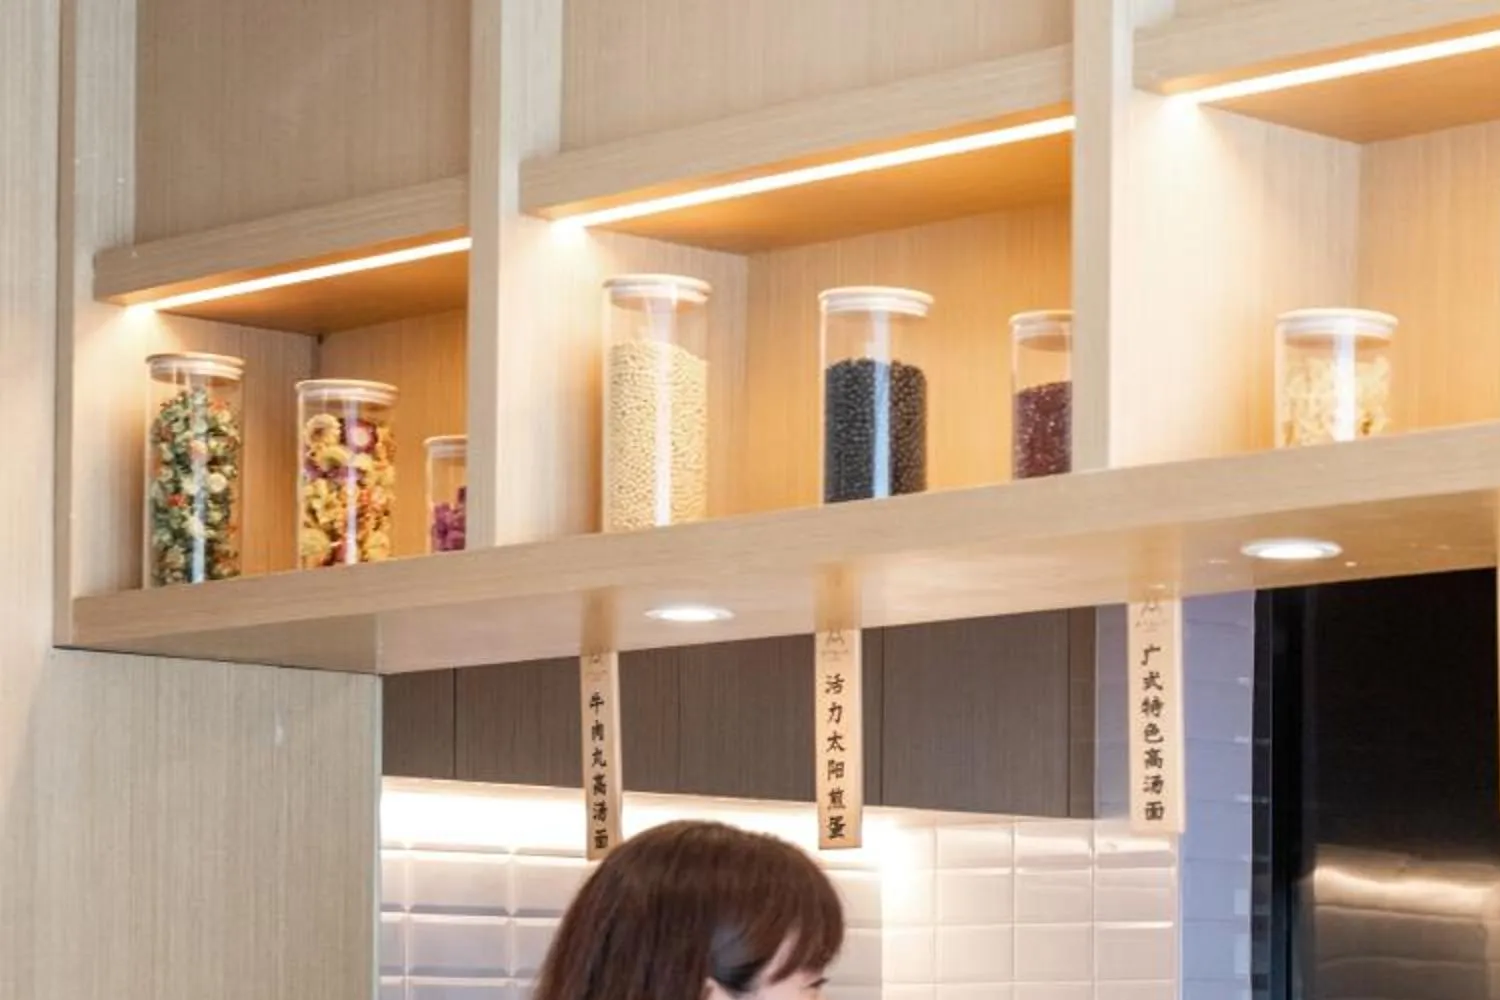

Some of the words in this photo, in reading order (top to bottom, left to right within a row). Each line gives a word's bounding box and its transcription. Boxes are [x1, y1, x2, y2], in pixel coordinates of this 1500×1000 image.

[824, 673, 847, 840] 活力太阳煎蛋
[1140, 643, 1165, 821] 广式特色高汤面
